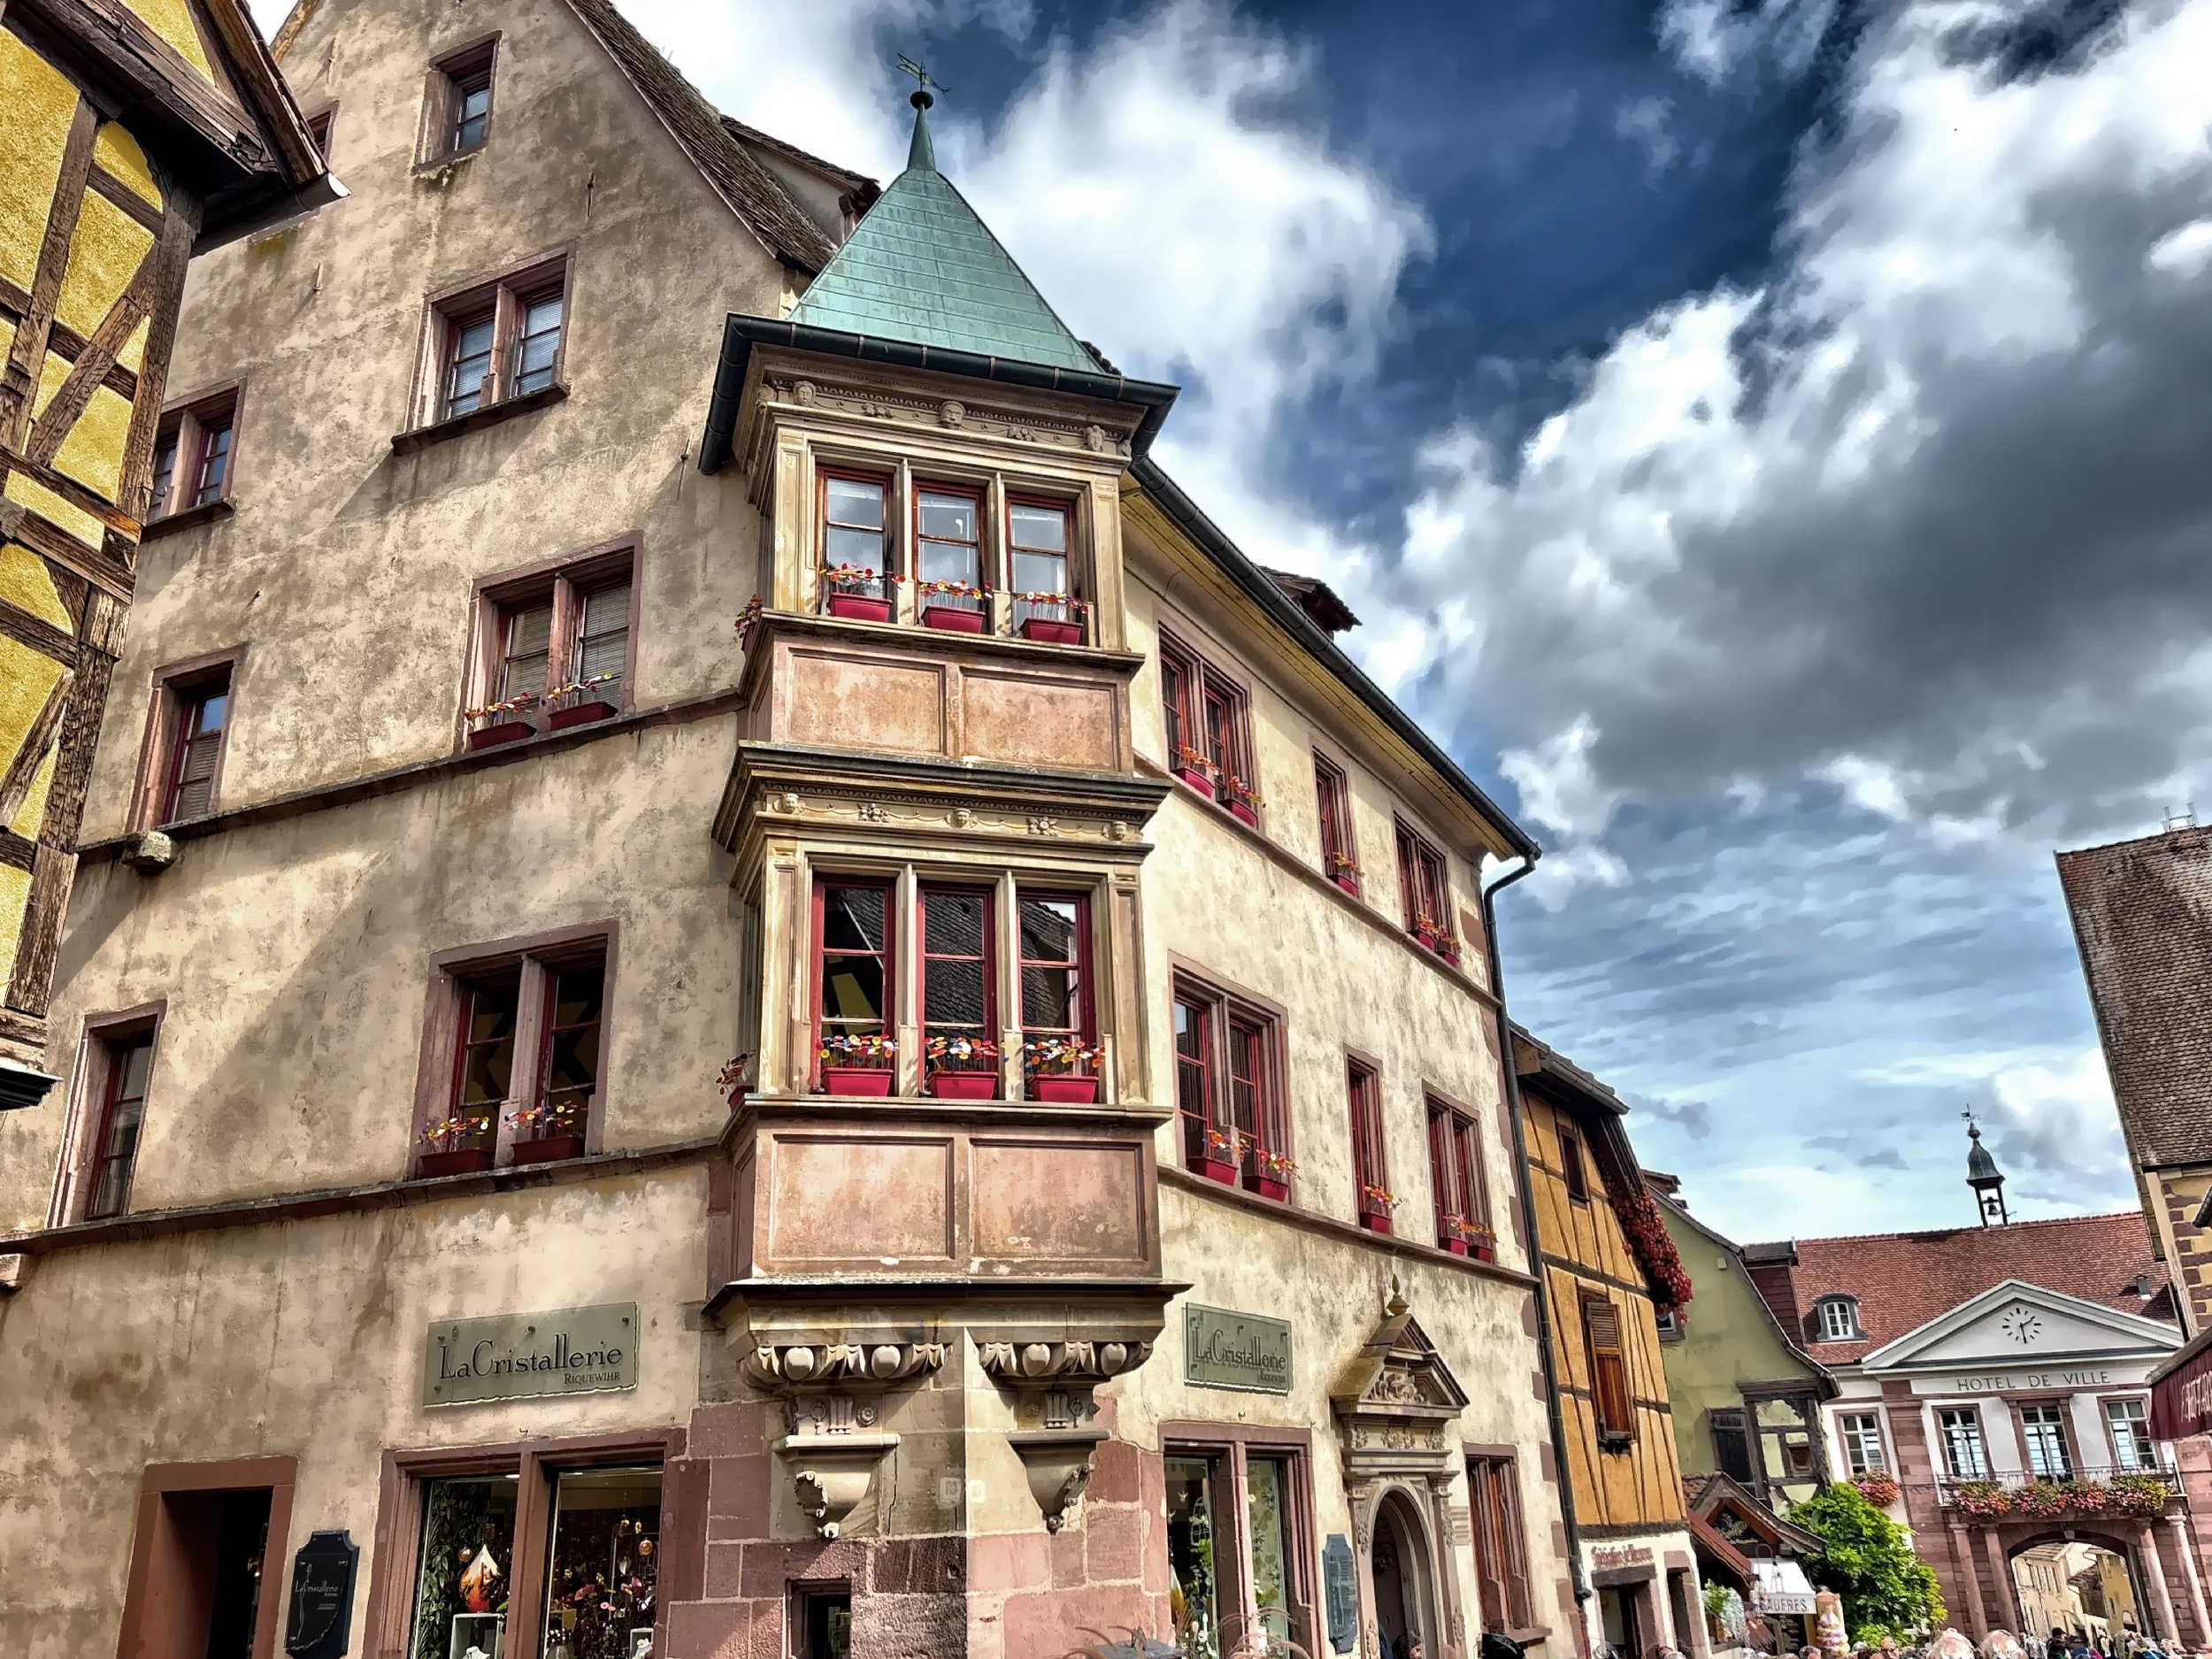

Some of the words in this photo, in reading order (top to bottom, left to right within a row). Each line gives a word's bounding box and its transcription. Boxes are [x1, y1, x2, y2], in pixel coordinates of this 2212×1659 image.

[564, 1371, 620, 1386] RIQUEWIHR
[1956, 1376, 2016, 1392] HOTEL
[2027, 1374, 2053, 1387] DE
[2062, 1371, 2111, 1386] VILLE
